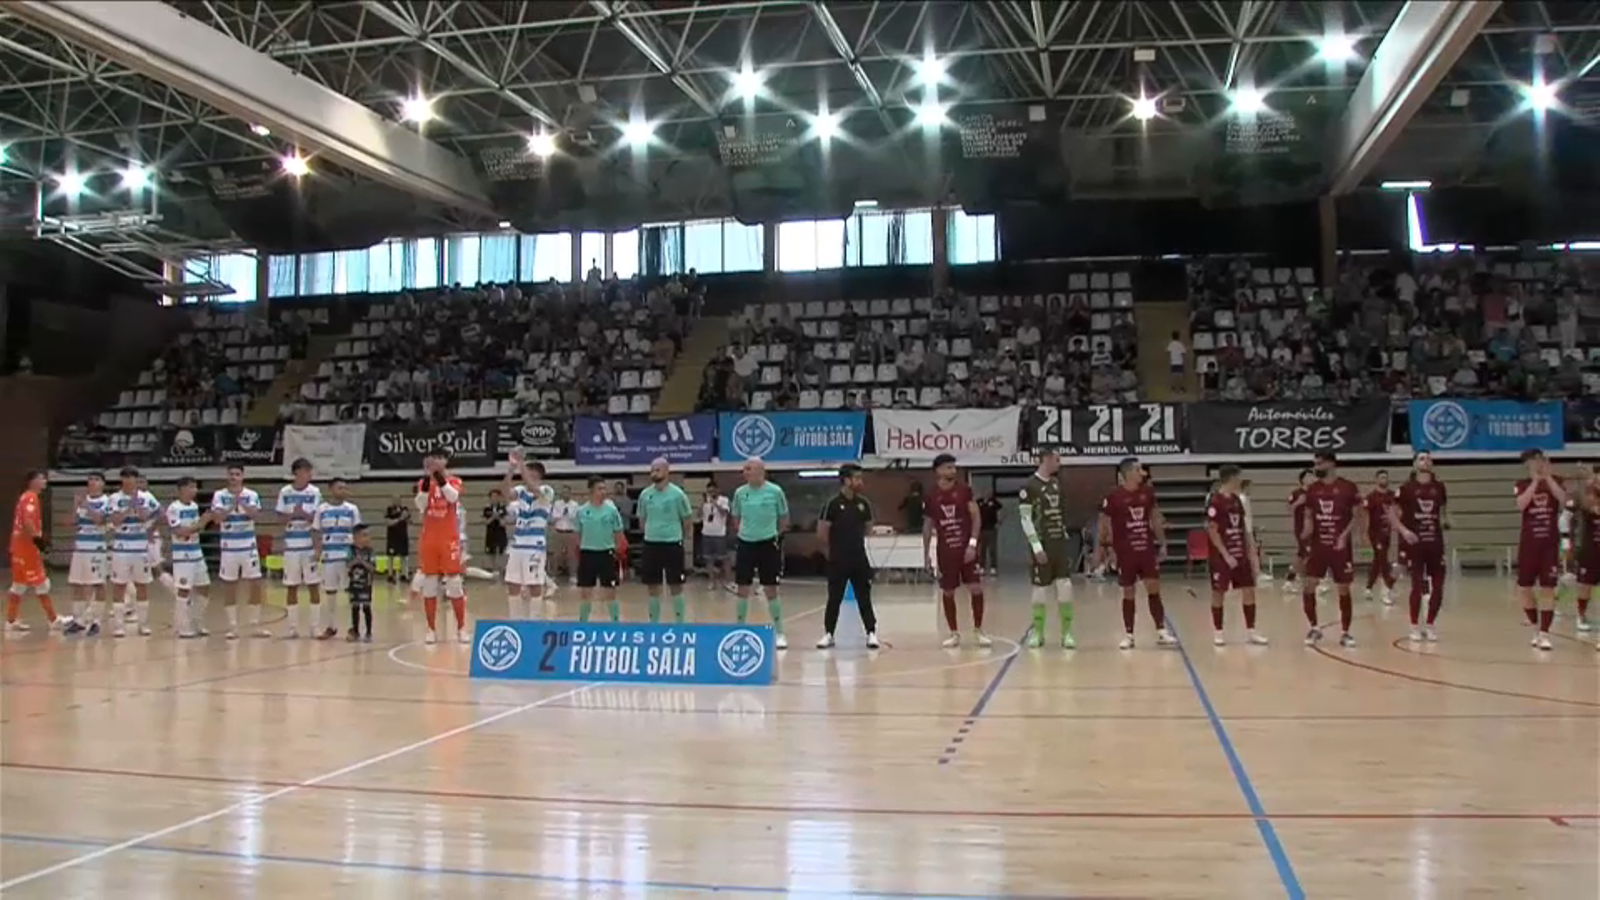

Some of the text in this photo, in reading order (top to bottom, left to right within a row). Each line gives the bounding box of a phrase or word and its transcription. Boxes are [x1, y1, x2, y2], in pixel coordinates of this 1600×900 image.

[1247, 406, 1335, 422] Automóviles
[964, 431, 1005, 452] viajes
[1235, 426, 1347, 450] TORRES
[1083, 445, 1128, 454] HEREDIA
[1135, 444, 1180, 453] HEREDIA
[573, 627, 697, 645] DIVISIÓN
[569, 641, 695, 676] FÚTBOL SALA
